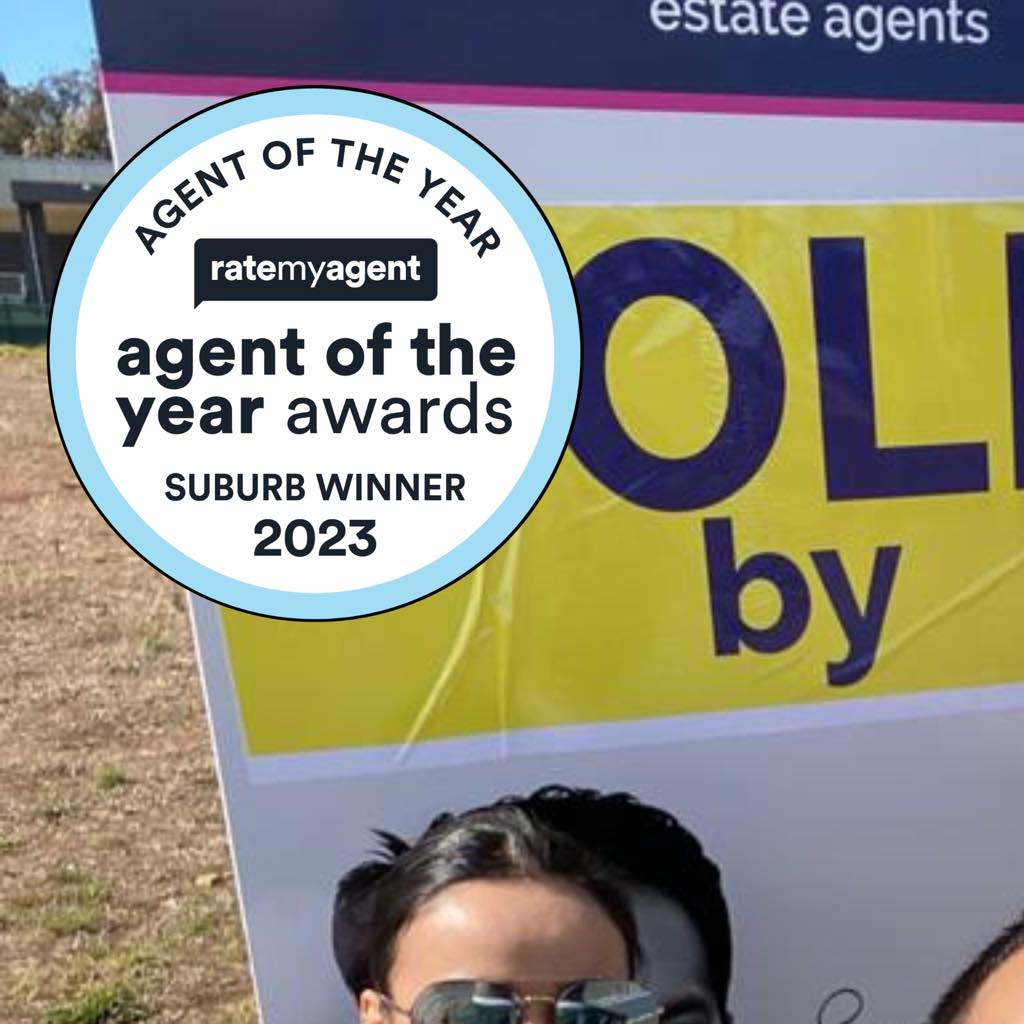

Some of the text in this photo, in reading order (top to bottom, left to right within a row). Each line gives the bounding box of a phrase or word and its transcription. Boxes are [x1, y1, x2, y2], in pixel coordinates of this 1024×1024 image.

[650, 0, 990, 52] estate agents
[702, 517, 902, 686] by
